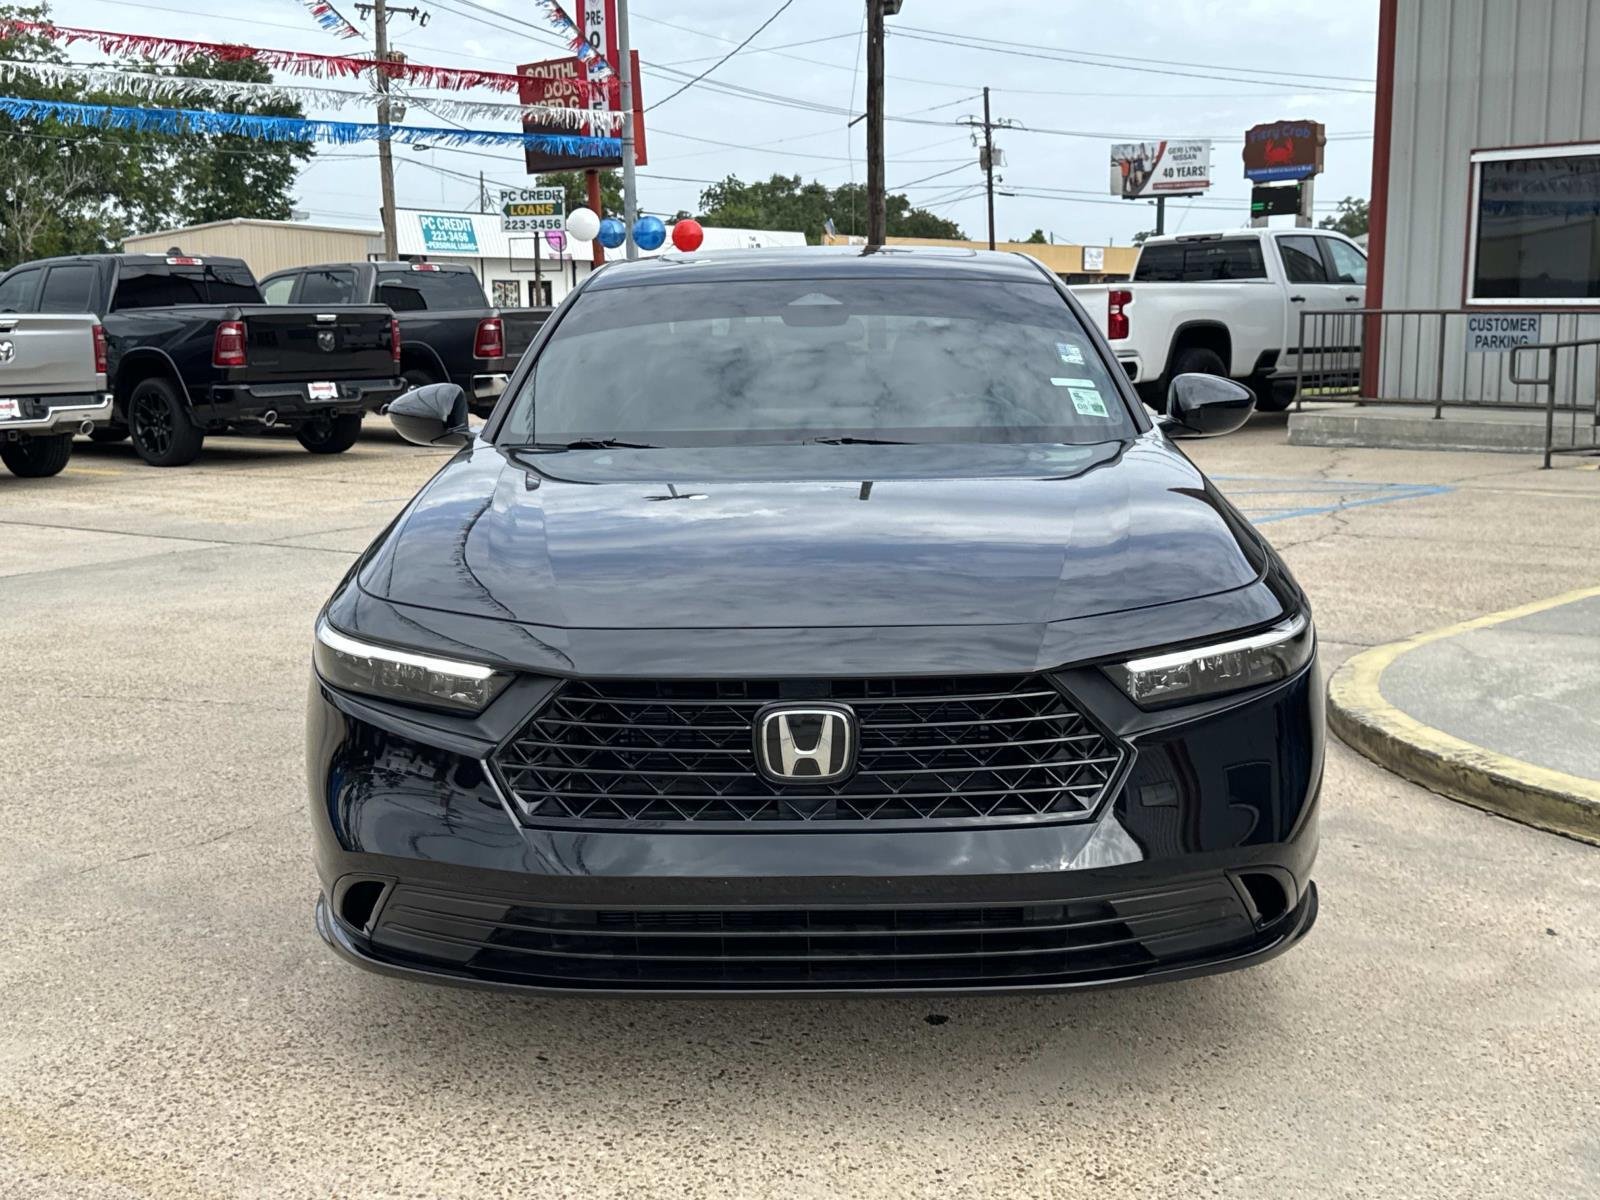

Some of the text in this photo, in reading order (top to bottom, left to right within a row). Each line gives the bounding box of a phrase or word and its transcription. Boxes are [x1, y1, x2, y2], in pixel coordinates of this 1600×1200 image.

[1163, 166, 1206, 178] 40 YEARS!
[500, 190, 563, 202] PC CREDIT
[511, 203, 554, 216] LOANS
[420, 216, 472, 232] PC CREDIT
[1469, 318, 1537, 332] CUSTOMER
[1475, 335, 1529, 349] PARKING
